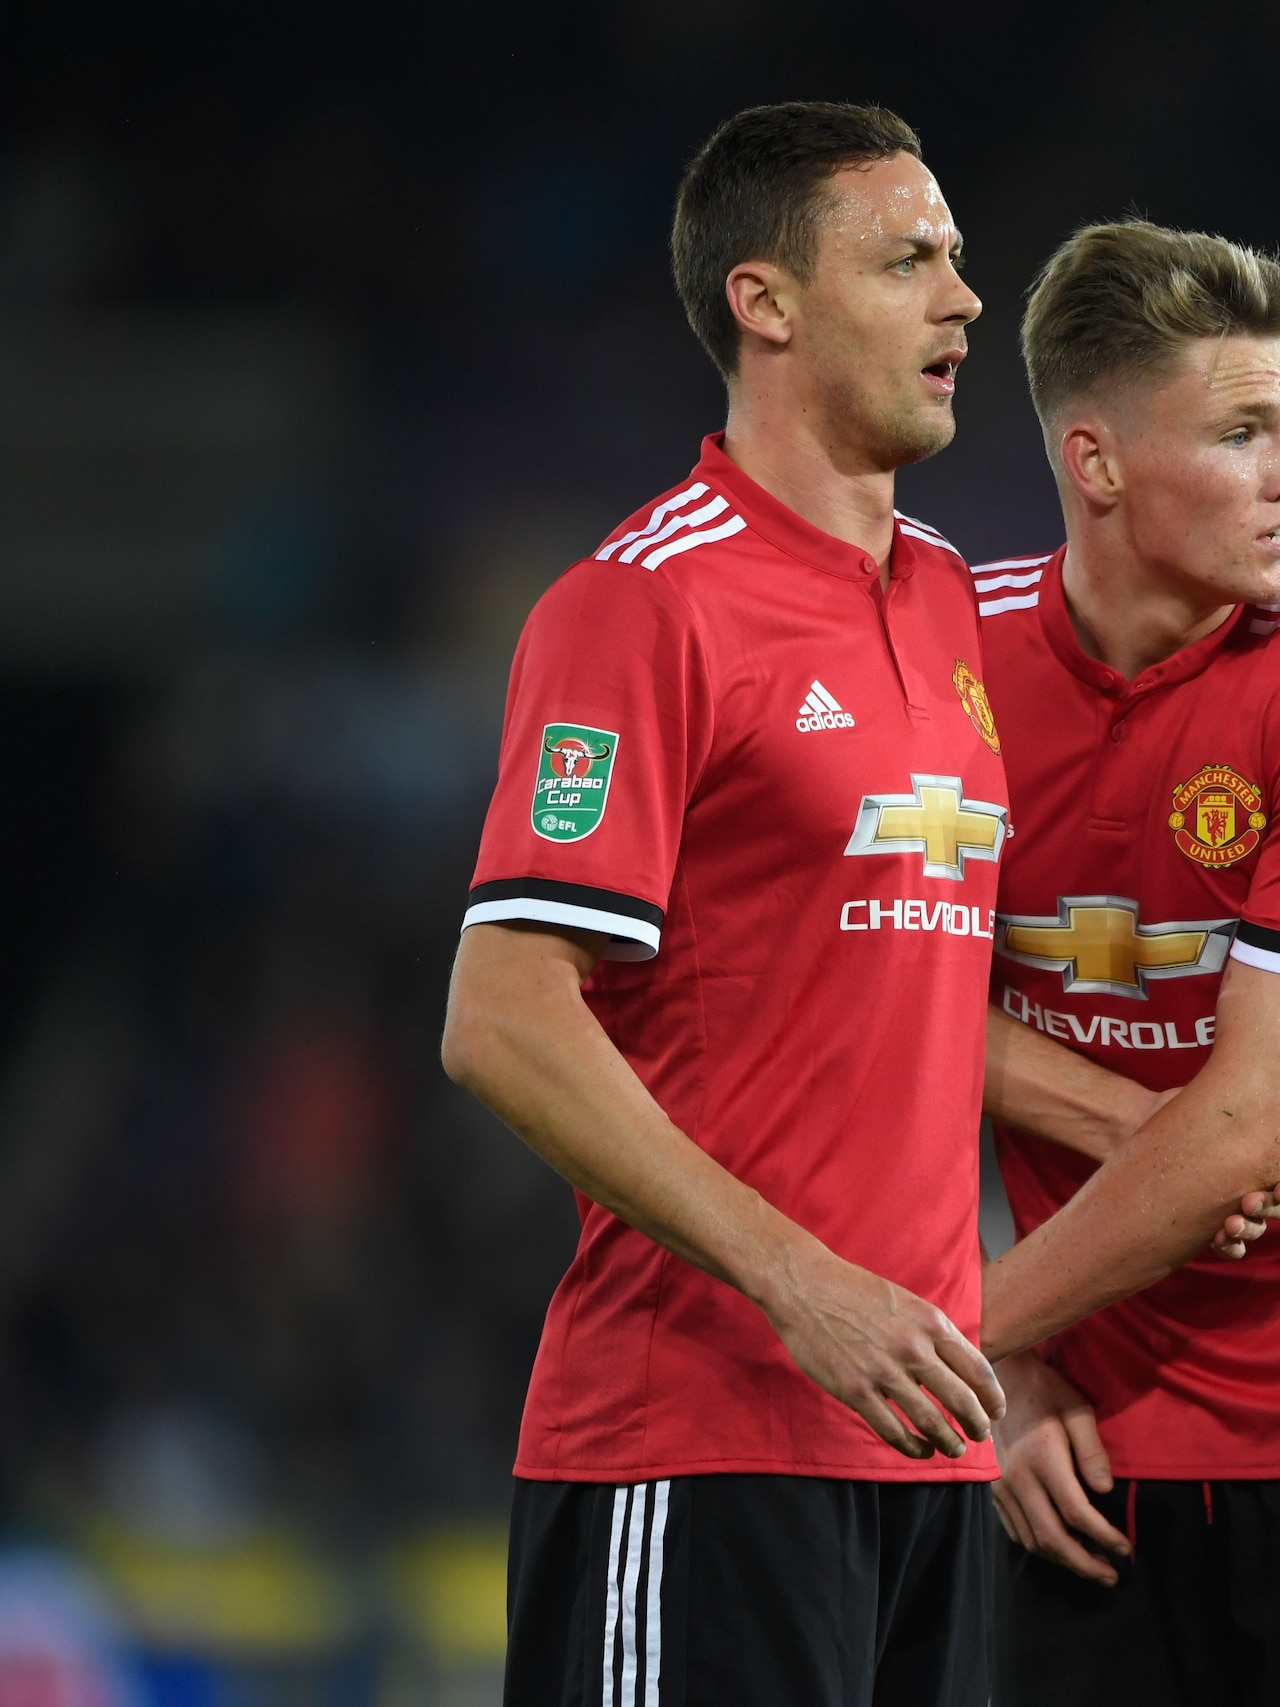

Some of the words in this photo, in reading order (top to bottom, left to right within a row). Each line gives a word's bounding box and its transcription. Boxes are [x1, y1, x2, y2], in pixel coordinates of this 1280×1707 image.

[795, 710, 855, 733] adidas
[537, 775, 603, 794] Carabao
[1180, 773, 1255, 806] MANCHESTER
[547, 790, 582, 807] Cup
[558, 819, 577, 832] EFL
[1189, 843, 1245, 861] UNITED
